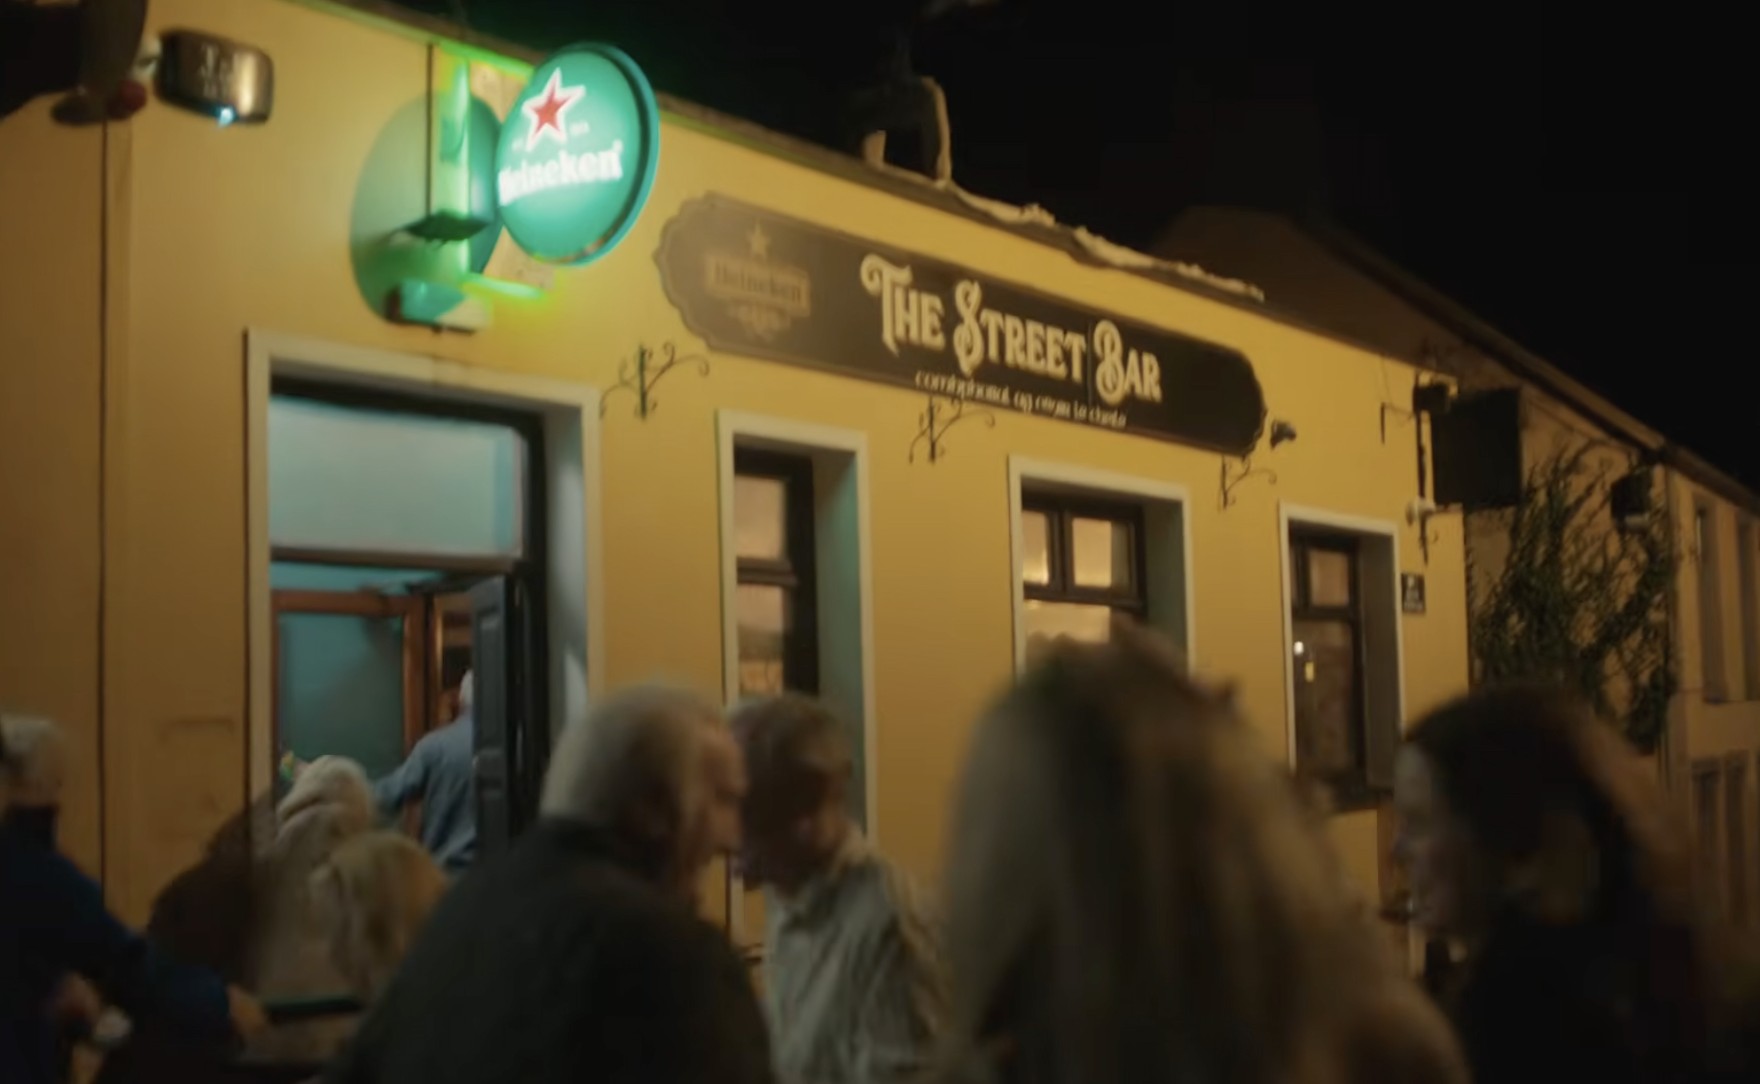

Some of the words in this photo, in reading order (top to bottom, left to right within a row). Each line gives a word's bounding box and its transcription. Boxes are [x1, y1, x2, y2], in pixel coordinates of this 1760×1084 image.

[860, 253, 946, 357] THE
[953, 279, 1088, 384] STREET
[1093, 319, 1162, 406] BAR
